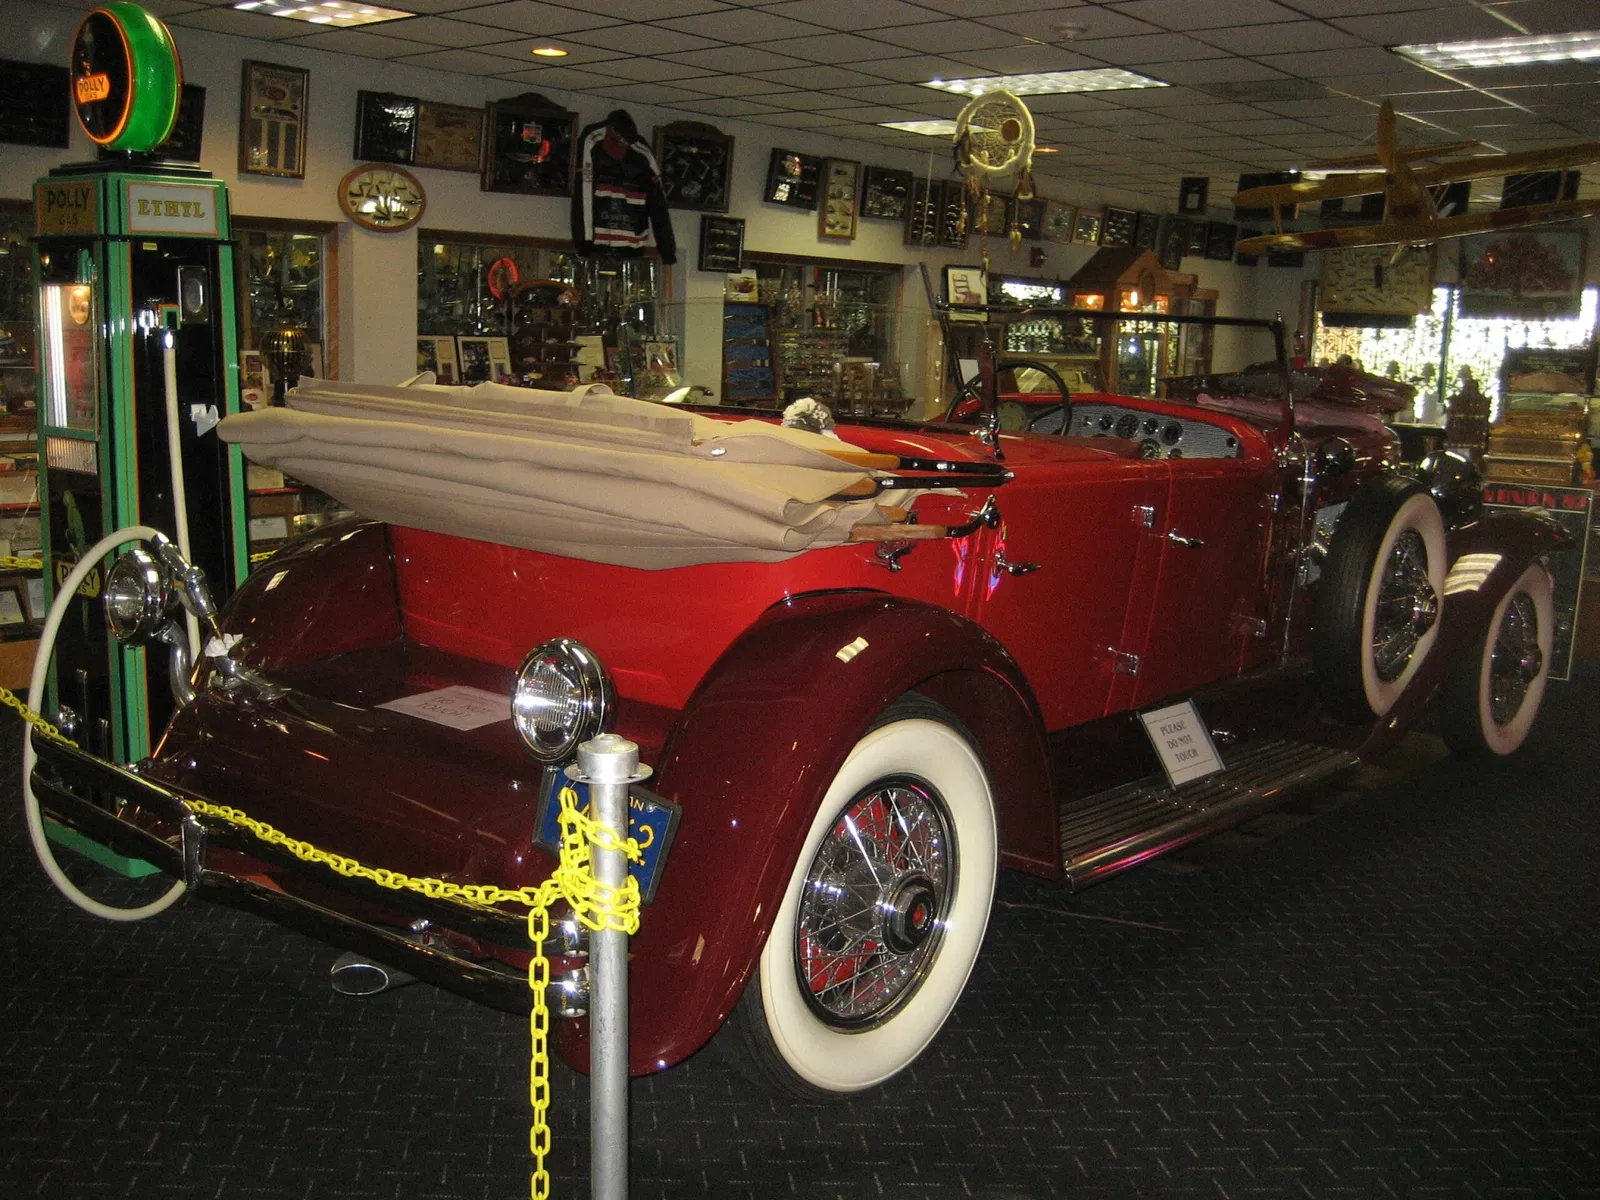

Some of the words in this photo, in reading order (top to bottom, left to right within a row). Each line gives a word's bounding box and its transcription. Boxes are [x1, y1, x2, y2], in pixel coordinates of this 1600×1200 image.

[79, 77, 105, 93] POLLY
[47, 187, 91, 213] POLLY
[137, 199, 206, 218] ETHYL
[1160, 720, 1187, 736] PLEASE
[1166, 738, 1179, 750] DO
[1177, 734, 1193, 746] NOT
[1175, 748, 1199, 763] TOUCH
